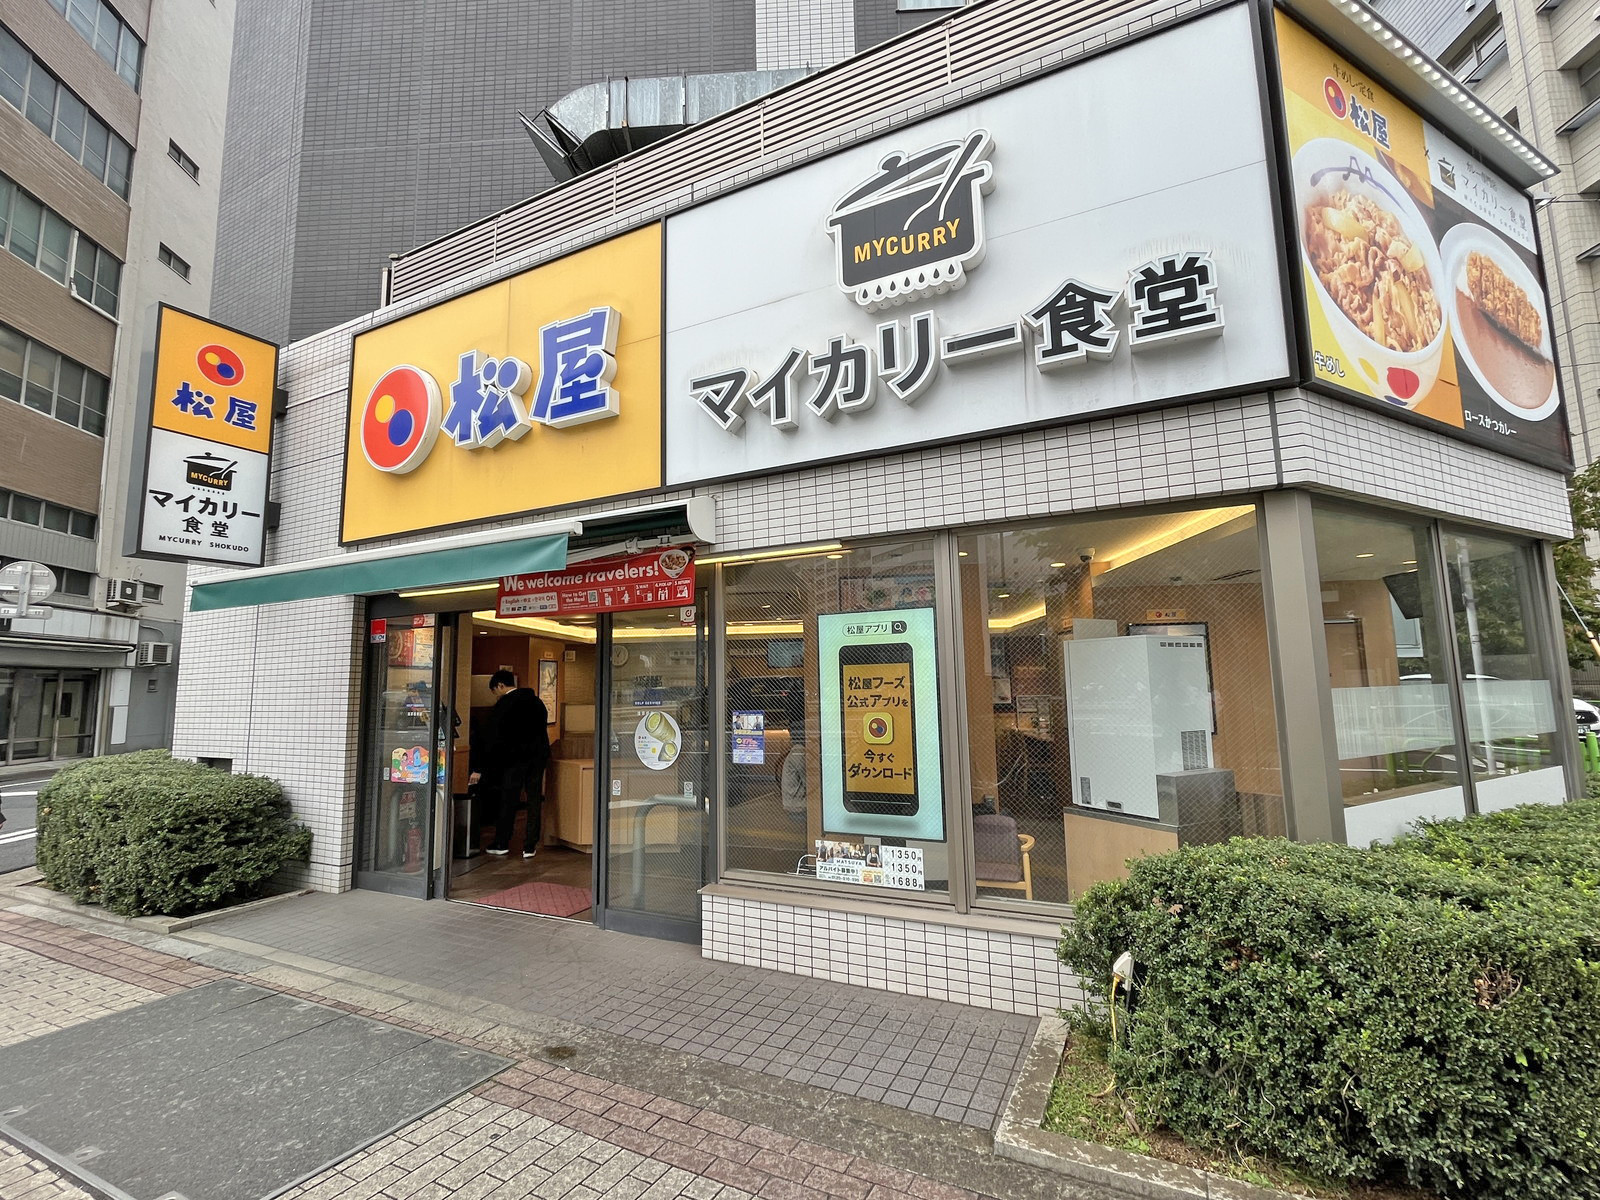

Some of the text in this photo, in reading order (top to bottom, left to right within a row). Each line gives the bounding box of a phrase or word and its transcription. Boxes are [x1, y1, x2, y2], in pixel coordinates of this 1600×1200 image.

[1348, 93, 1391, 151] 松屋
[853, 218, 960, 264] MYCURRY
[690, 251, 1222, 432] マイカリー食堂
[441, 306, 620, 448] 松屋
[1313, 350, 1345, 378] 牛めし
[171, 381, 258, 431] 松屋
[1464, 409, 1517, 436] ロースかつカレー
[190, 471, 229, 487] MYCURRY
[148, 489, 261, 519] マイカリー
[182, 516, 229, 539] 食堂
[159, 535, 249, 552] MYCURRY SHOKUDO
[503, 560, 659, 592] We welcome travelers!
[846, 624, 888, 635] 松屋アプリ
[848, 676, 906, 690] 松屋フーズ
[847, 694, 909, 708] 公式アプリを
[863, 749, 895, 763] 今すぐ
[848, 763, 912, 780] ダウンロード
